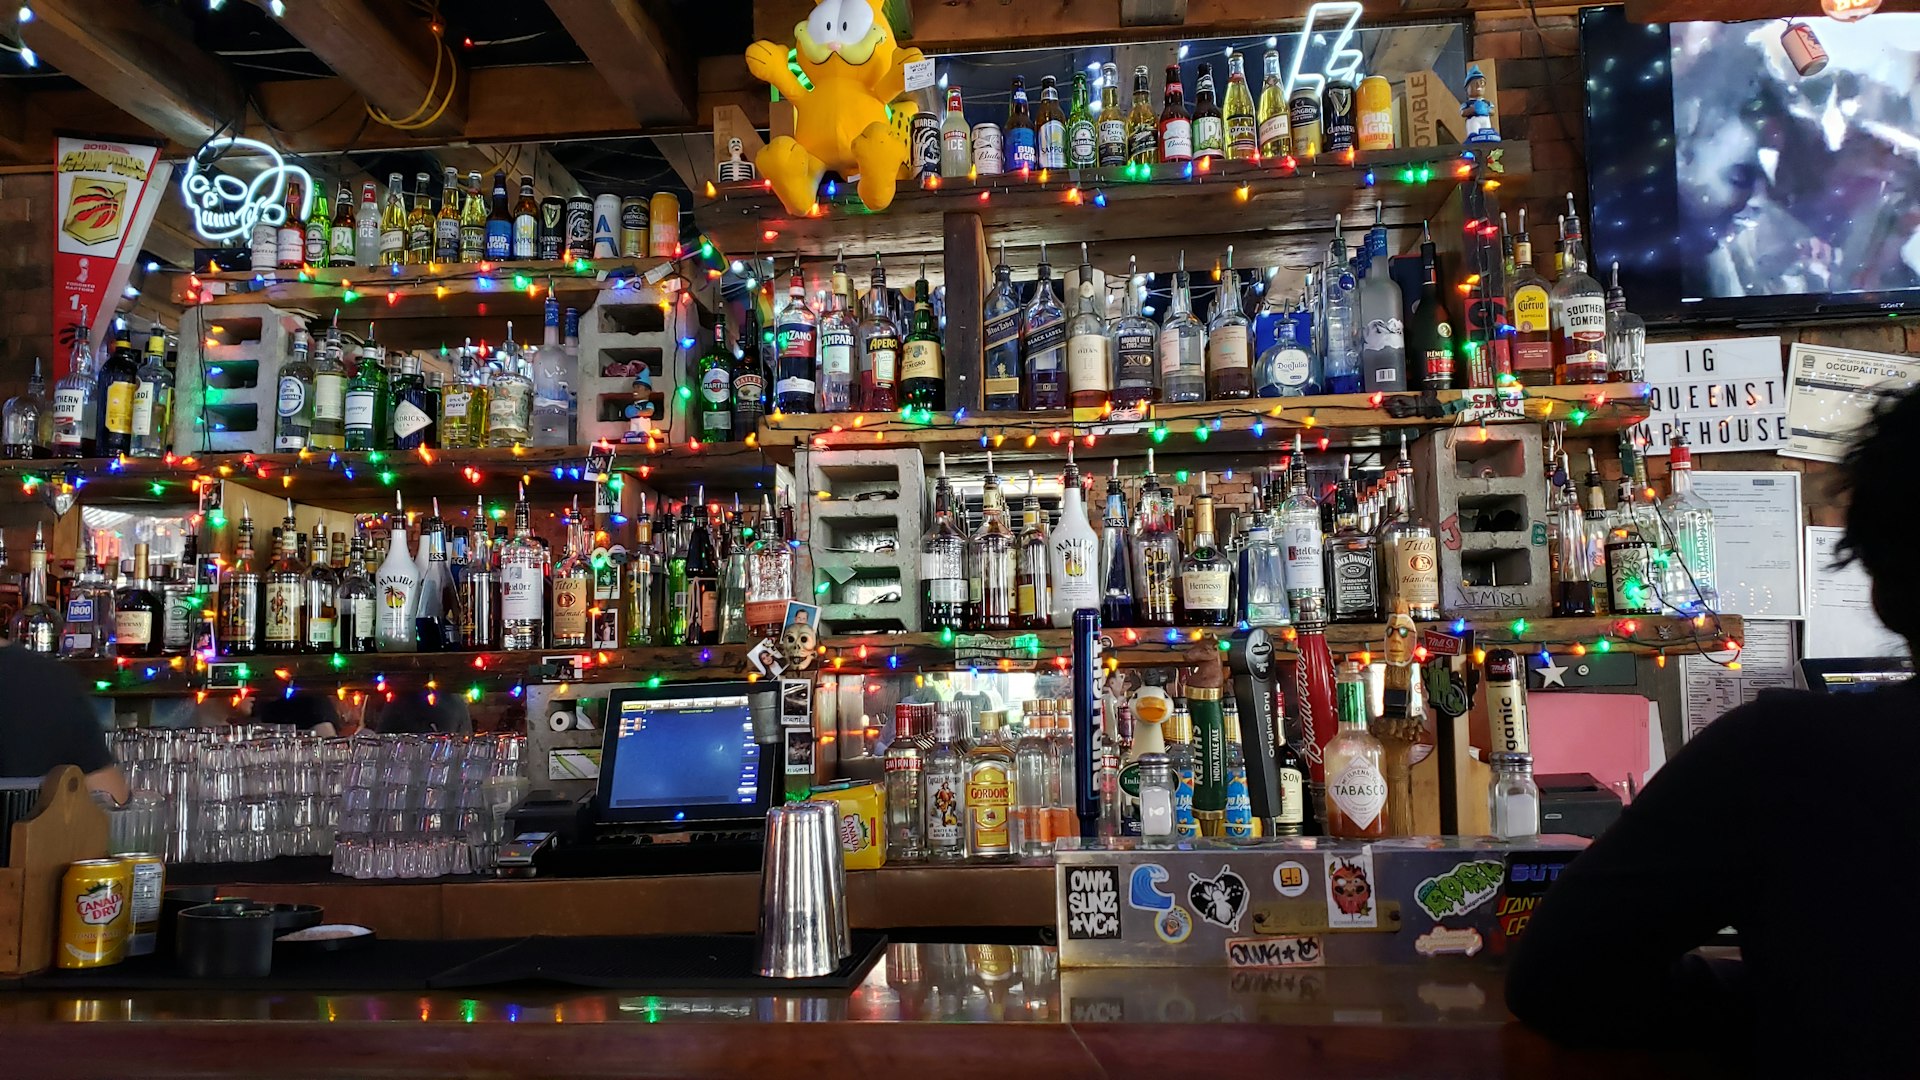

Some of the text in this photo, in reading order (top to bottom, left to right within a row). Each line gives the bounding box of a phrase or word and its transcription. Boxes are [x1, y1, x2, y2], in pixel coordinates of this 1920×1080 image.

[1327, 126, 1356, 135] GUINNESS
[947, 140, 963, 151] ICE
[1017, 145, 1035, 154] BUD
[488, 235, 507, 243] BUD
[486, 242, 510, 250] LIGHT
[1518, 301, 1544, 312] Cuervo
[999, 319, 1015, 332] Label
[777, 330, 812, 342] CINZANO
[1027, 328, 1063, 346] BLACK LABEL
[1121, 336, 1140, 344] MOUNT
[1123, 354, 1152, 367] XO
[1825, 362, 1878, 375] OCCUPANT
[704, 382, 730, 390] MARTINI
[1474, 409, 1521, 419] ALUMNI
[1531, 520, 1547, 547] B
[1405, 539, 1435, 551] Tito's
[1334, 555, 1349, 568] JACK
[379, 575, 416, 589] MALIBU
[554, 580, 580, 591] Tito's
[1189, 582, 1222, 592] Hennessy
[70, 605, 91, 615] 1800
[1427, 636, 1445, 646] Mill
[1296, 647, 1323, 768] Budweiser
[1501, 697, 1519, 751] ganic
[1262, 711, 1275, 759] Original
[1211, 728, 1221, 782] INDIA PALE ALE
[885, 758, 921, 769] SMIRNOFF
[1334, 784, 1385, 796] TABASCO
[843, 814, 861, 853] CANADA
[1280, 867, 1302, 886] SB
[92, 904, 118, 920] DRY
